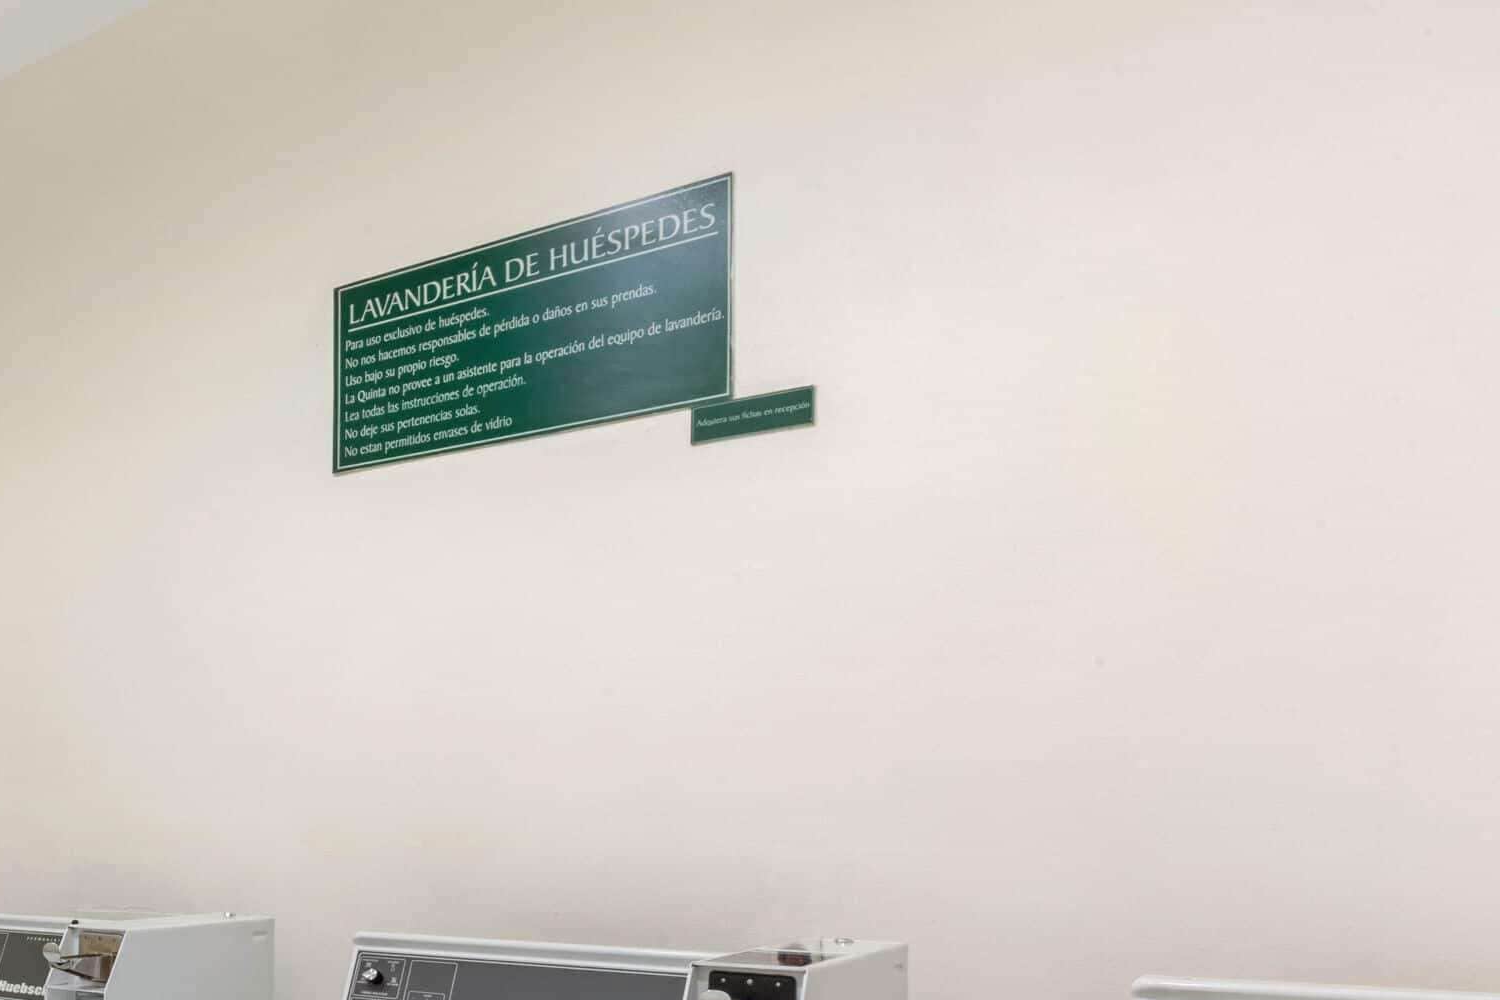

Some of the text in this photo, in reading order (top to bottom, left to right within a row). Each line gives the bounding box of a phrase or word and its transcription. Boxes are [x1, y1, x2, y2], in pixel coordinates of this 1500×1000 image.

[349, 202, 715, 325] LAVANDERÍA DE HUÉSPEDES
[344, 283, 657, 369] No nos hacemos responsables de pérdida o daños en sus prendas.
[345, 306, 490, 352] Para uso exclusivo de huéspedes.
[344, 307, 725, 405] La Quinta no provee a un asistente para la operación del equipo de lavandería.
[345, 353, 460, 387] Uso bajo su propio riesgo.
[344, 373, 527, 423] Lea todas las instrucciones de operación.
[344, 403, 481, 440] No deje sus pertenencias solas.
[344, 445, 359, 458] No
[384, 431, 431, 455] permitidos
[433, 425, 469, 441] envases
[470, 419, 483, 434] de
[484, 415, 513, 431] vidrio
